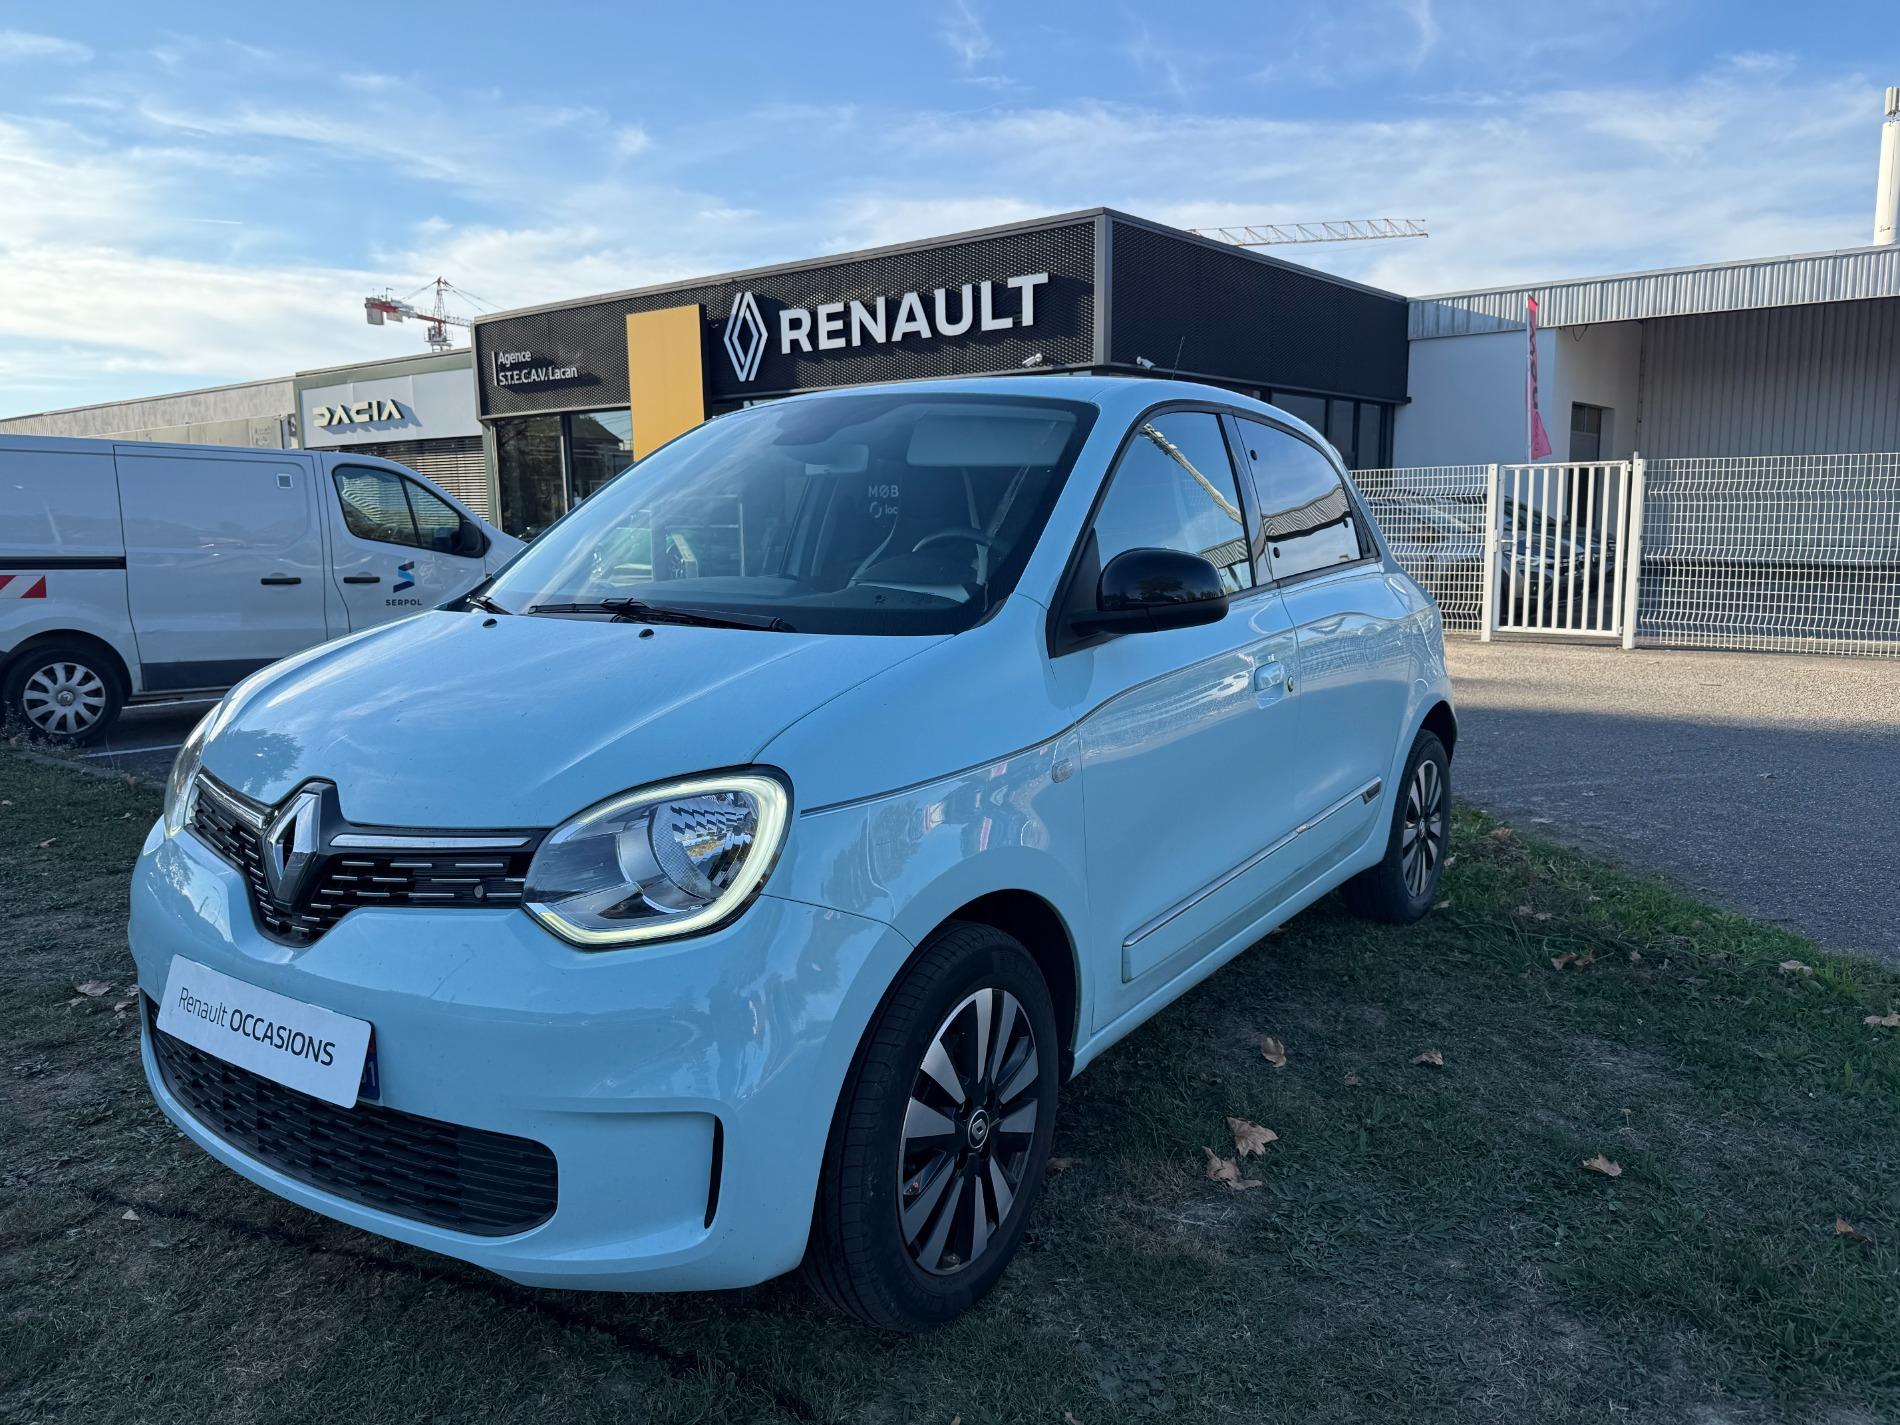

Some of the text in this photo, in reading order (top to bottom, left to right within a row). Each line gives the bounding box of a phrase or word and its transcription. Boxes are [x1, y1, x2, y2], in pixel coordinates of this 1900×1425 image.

[779, 272, 1049, 354] RENAULT
[498, 351, 532, 367] Agence
[548, 366, 578, 380] Lacan
[312, 399, 404, 427] DACIA
[385, 598, 422, 606] SERPOL
[178, 986, 336, 1066] Renault OCCASIONS
